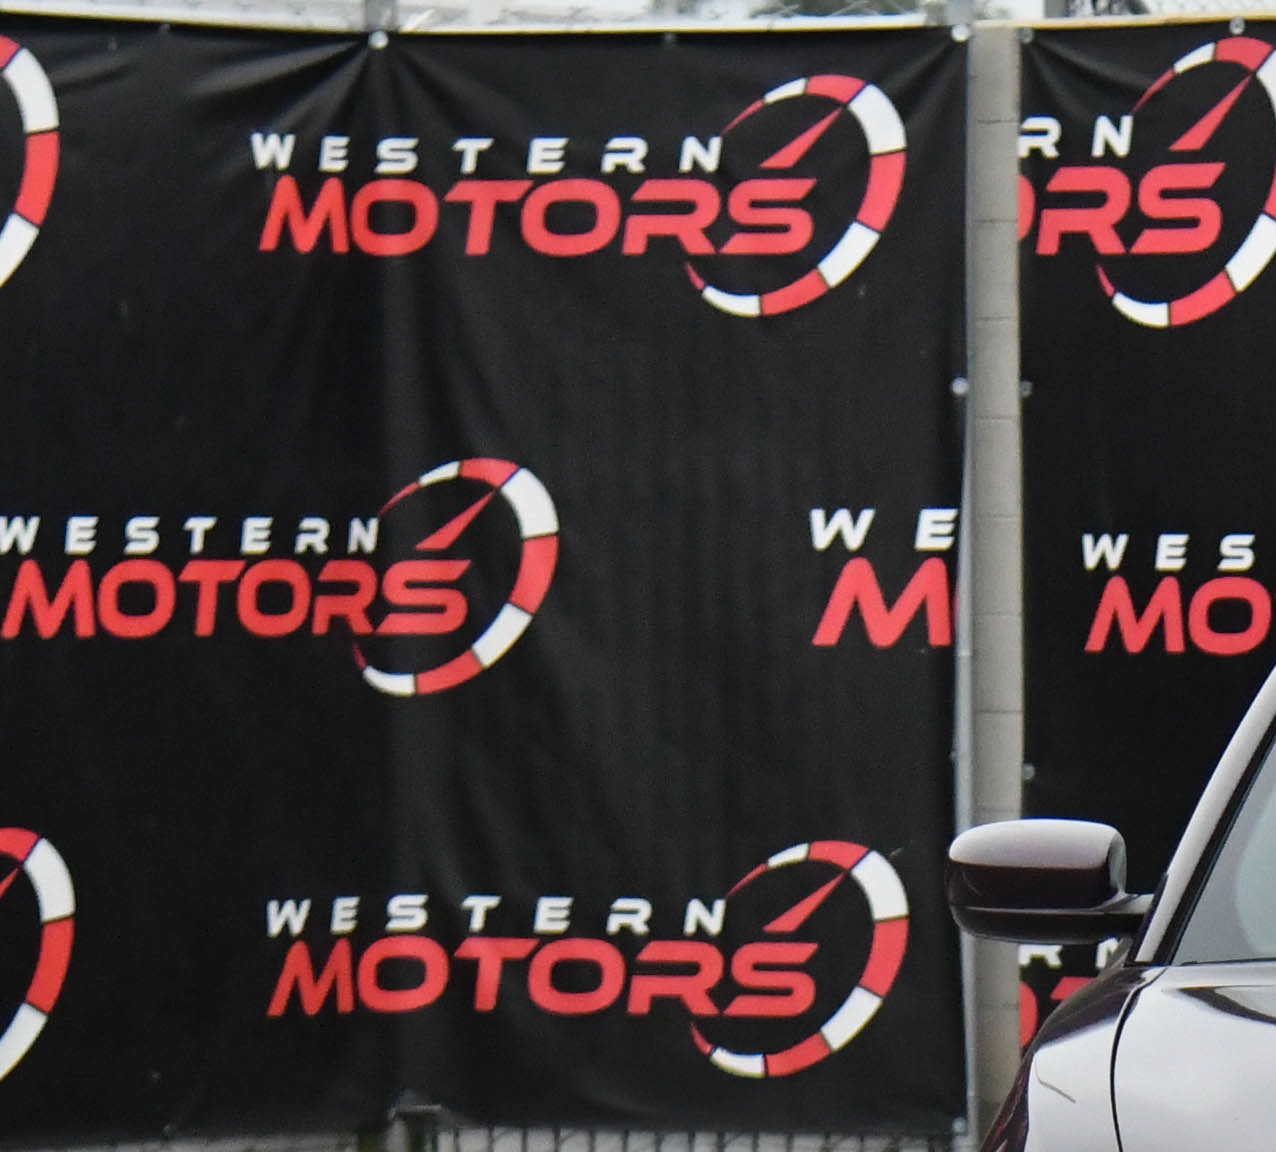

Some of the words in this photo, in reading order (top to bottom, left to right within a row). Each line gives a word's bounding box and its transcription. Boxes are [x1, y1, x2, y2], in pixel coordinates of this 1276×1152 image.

[251, 133, 723, 174] WESTERN
[259, 175, 818, 257] MOTORS
[0, 516, 380, 555] WESTERN
[1, 559, 471, 641] MOTORS
[267, 895, 726, 937] WESTERN
[267, 937, 819, 1018] MOTORS
